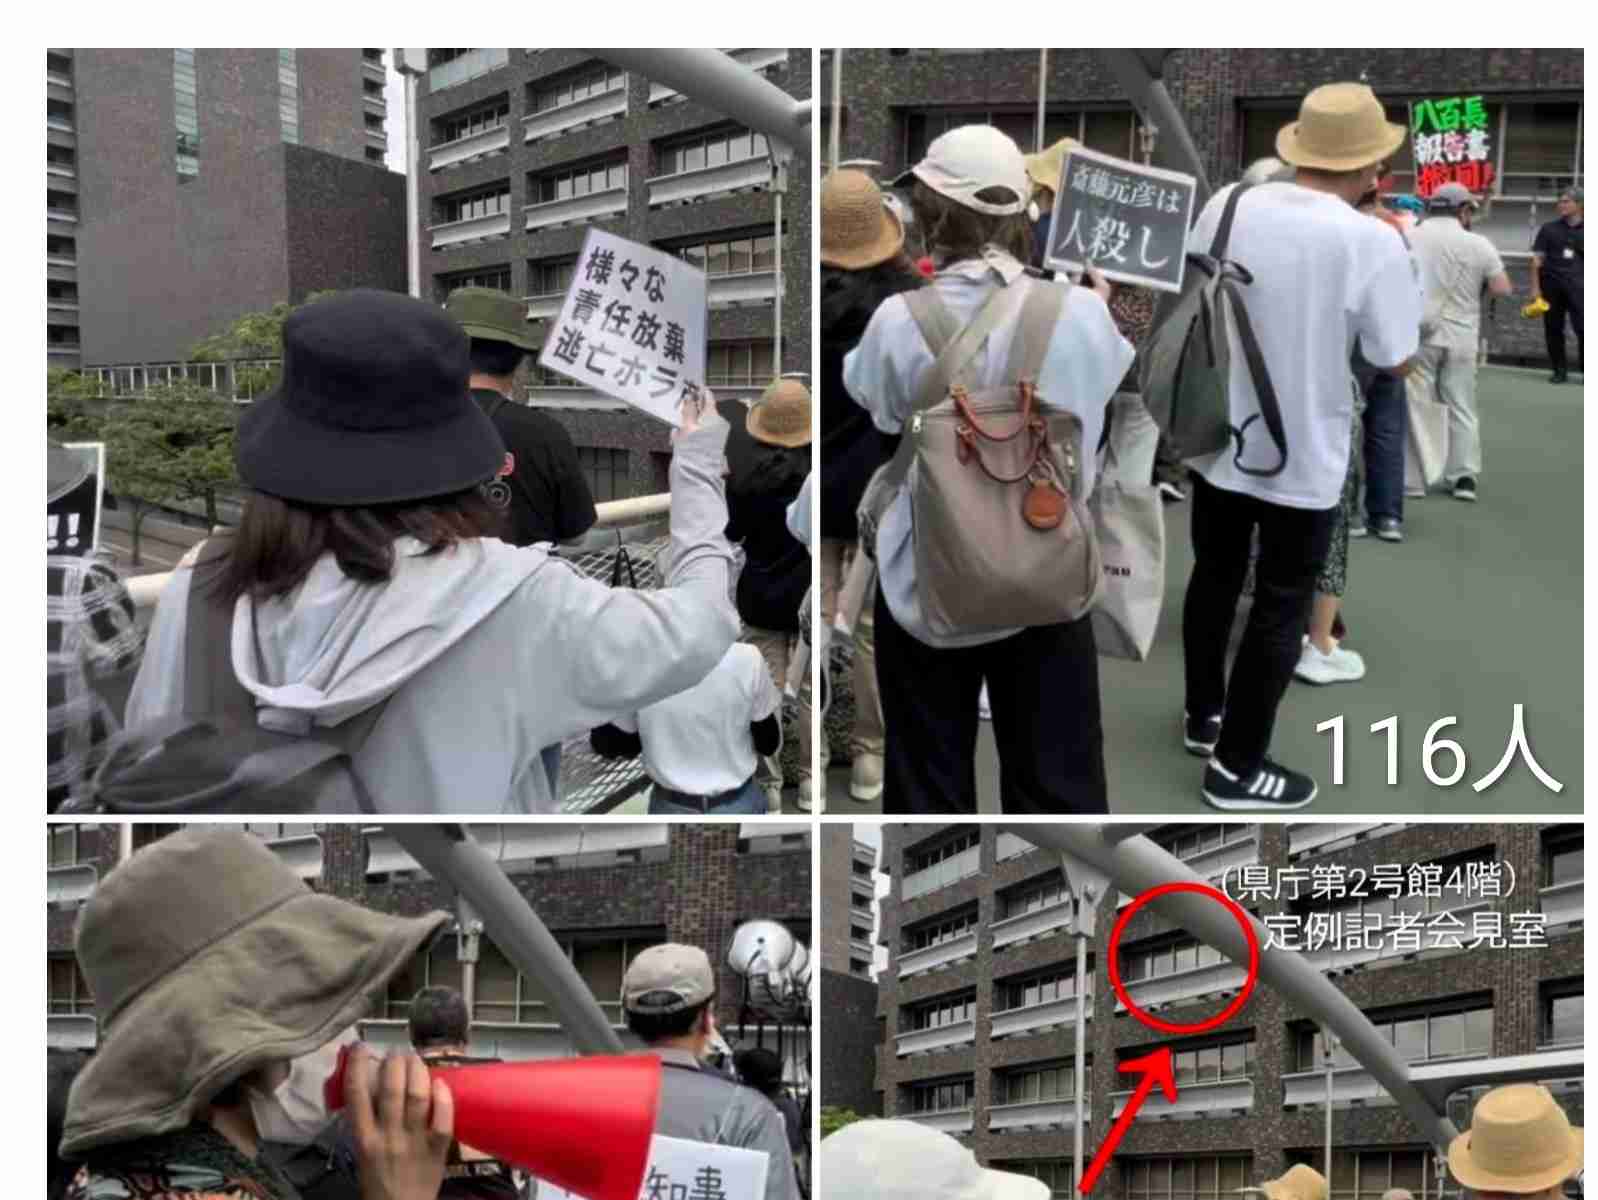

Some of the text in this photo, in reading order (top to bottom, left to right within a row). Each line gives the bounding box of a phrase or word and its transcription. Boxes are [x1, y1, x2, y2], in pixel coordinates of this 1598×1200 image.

[1059, 209, 1169, 268] 人殺し
[585, 246, 666, 302] 様々な
[572, 287, 685, 364] 責任放棄
